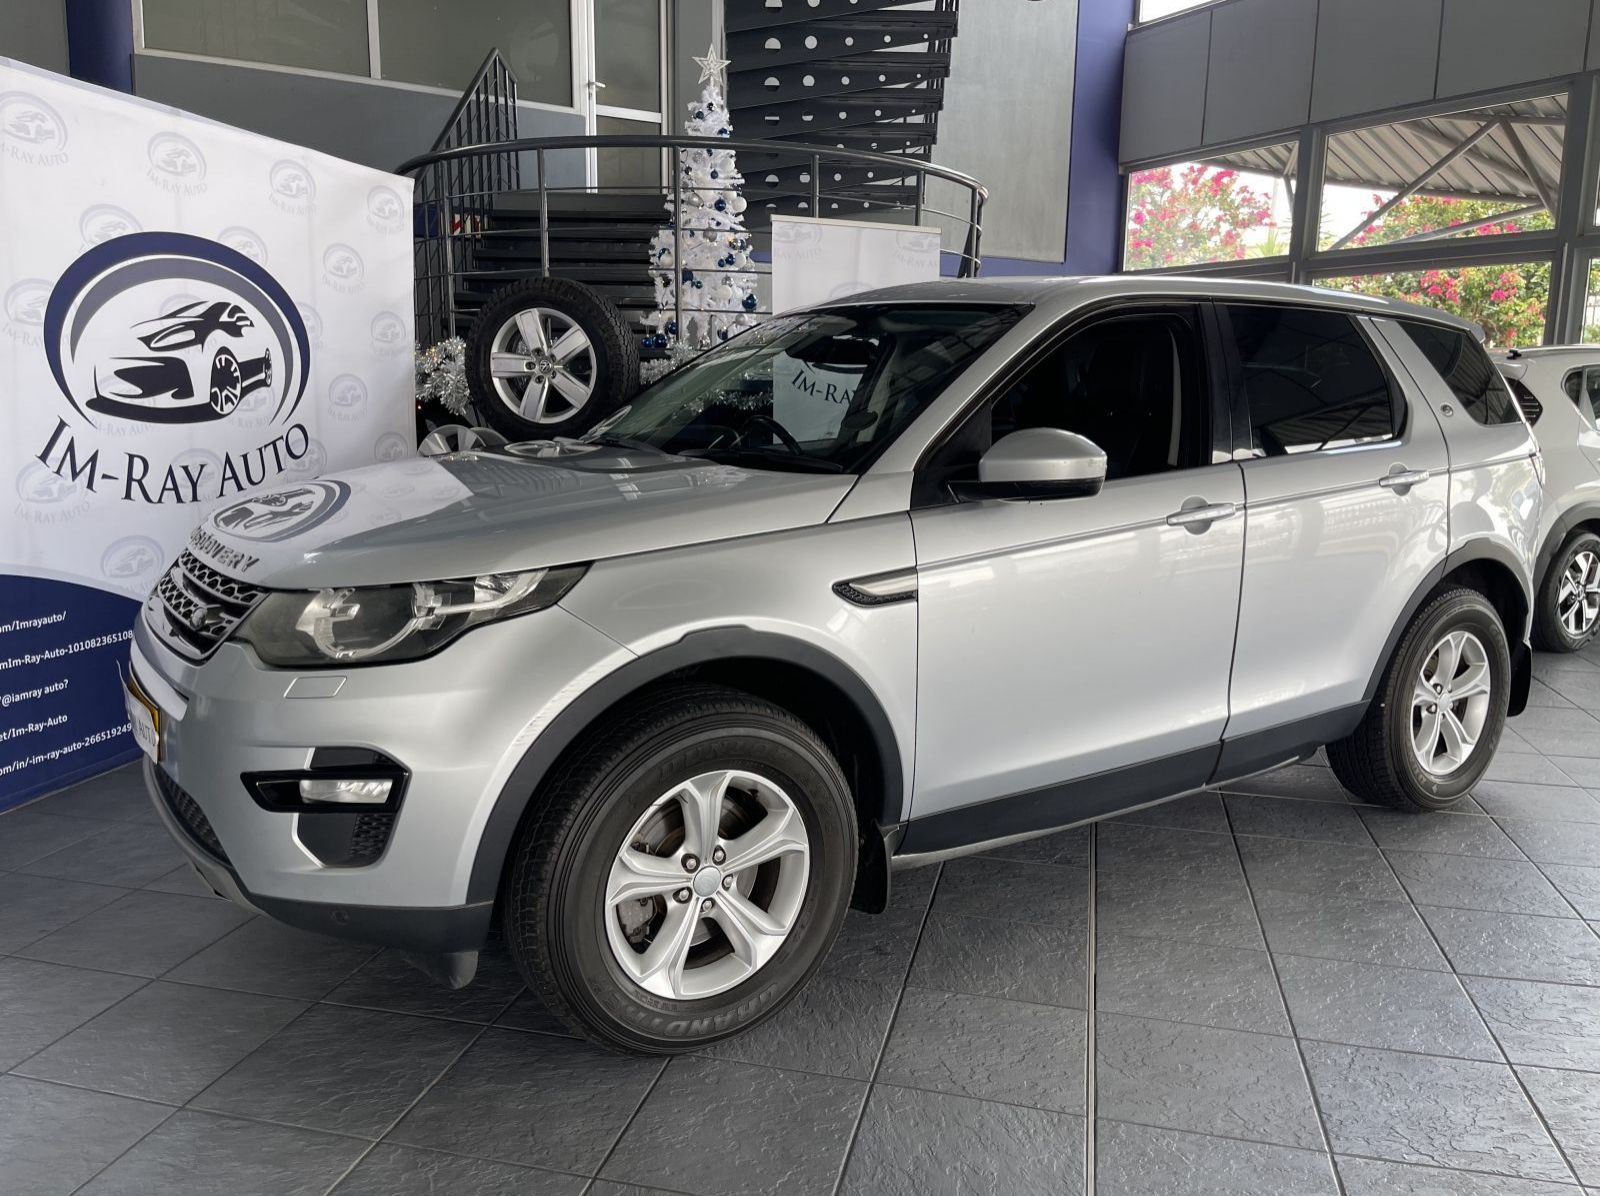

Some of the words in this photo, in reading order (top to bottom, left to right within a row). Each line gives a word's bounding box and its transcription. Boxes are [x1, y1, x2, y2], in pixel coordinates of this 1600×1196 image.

[38, 151, 70, 168] AUTO
[792, 369, 856, 404] IM-RA
[35, 415, 208, 504] IM-RAY
[216, 423, 309, 499] AUTO
[59, 500, 91, 522] AUTO
[44, 679, 69, 695] auto?
